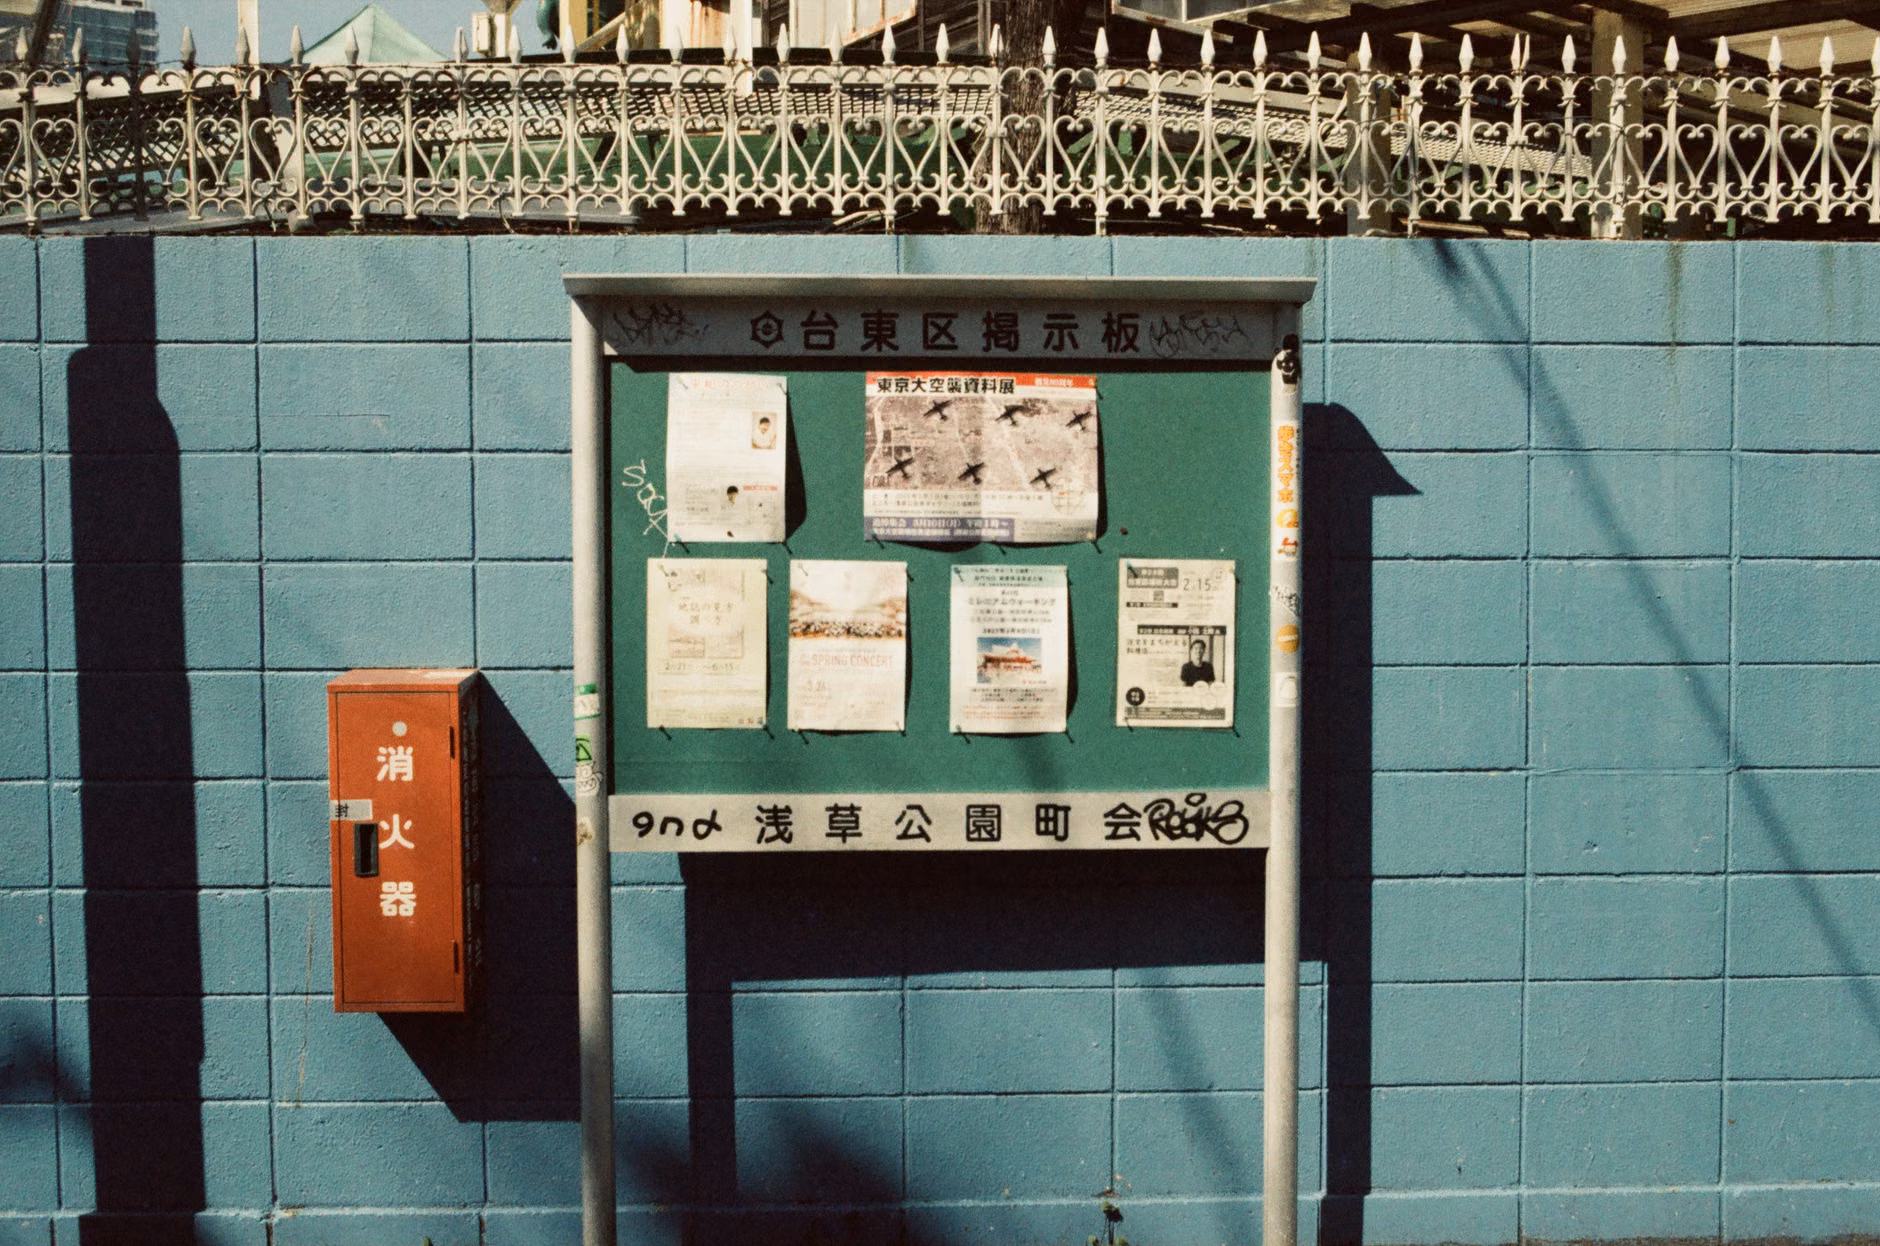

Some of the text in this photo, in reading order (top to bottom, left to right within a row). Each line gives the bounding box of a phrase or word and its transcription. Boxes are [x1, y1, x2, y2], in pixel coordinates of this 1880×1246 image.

[800, 308, 1140, 353] 台東区掲示板
[877, 376, 1016, 395] 東京大空襲資料展
[812, 653, 893, 668] SPRING CONCERT
[376, 745, 417, 917] 消火器
[754, 802, 1143, 844] 浅草公園町会
